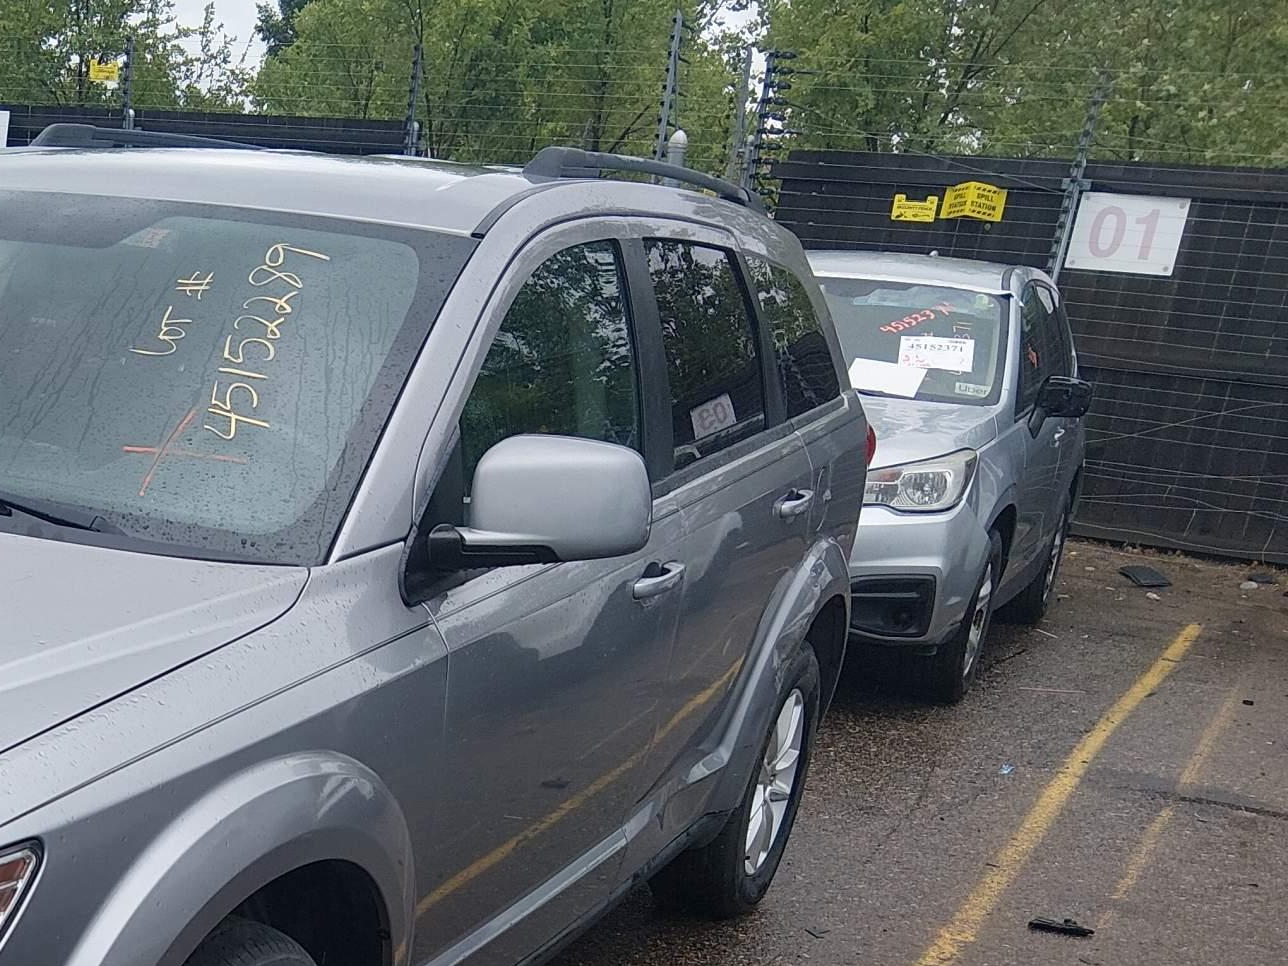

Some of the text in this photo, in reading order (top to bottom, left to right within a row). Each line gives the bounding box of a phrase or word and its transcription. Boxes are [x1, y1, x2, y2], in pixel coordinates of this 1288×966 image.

[976, 193, 994, 202] SPILL
[970, 200, 997, 211] STATION
[1088, 205, 1161, 261] 01
[203, 243, 331, 441] 45152289
[907, 343, 964, 353] 45152371
[958, 384, 989, 396] Uber
